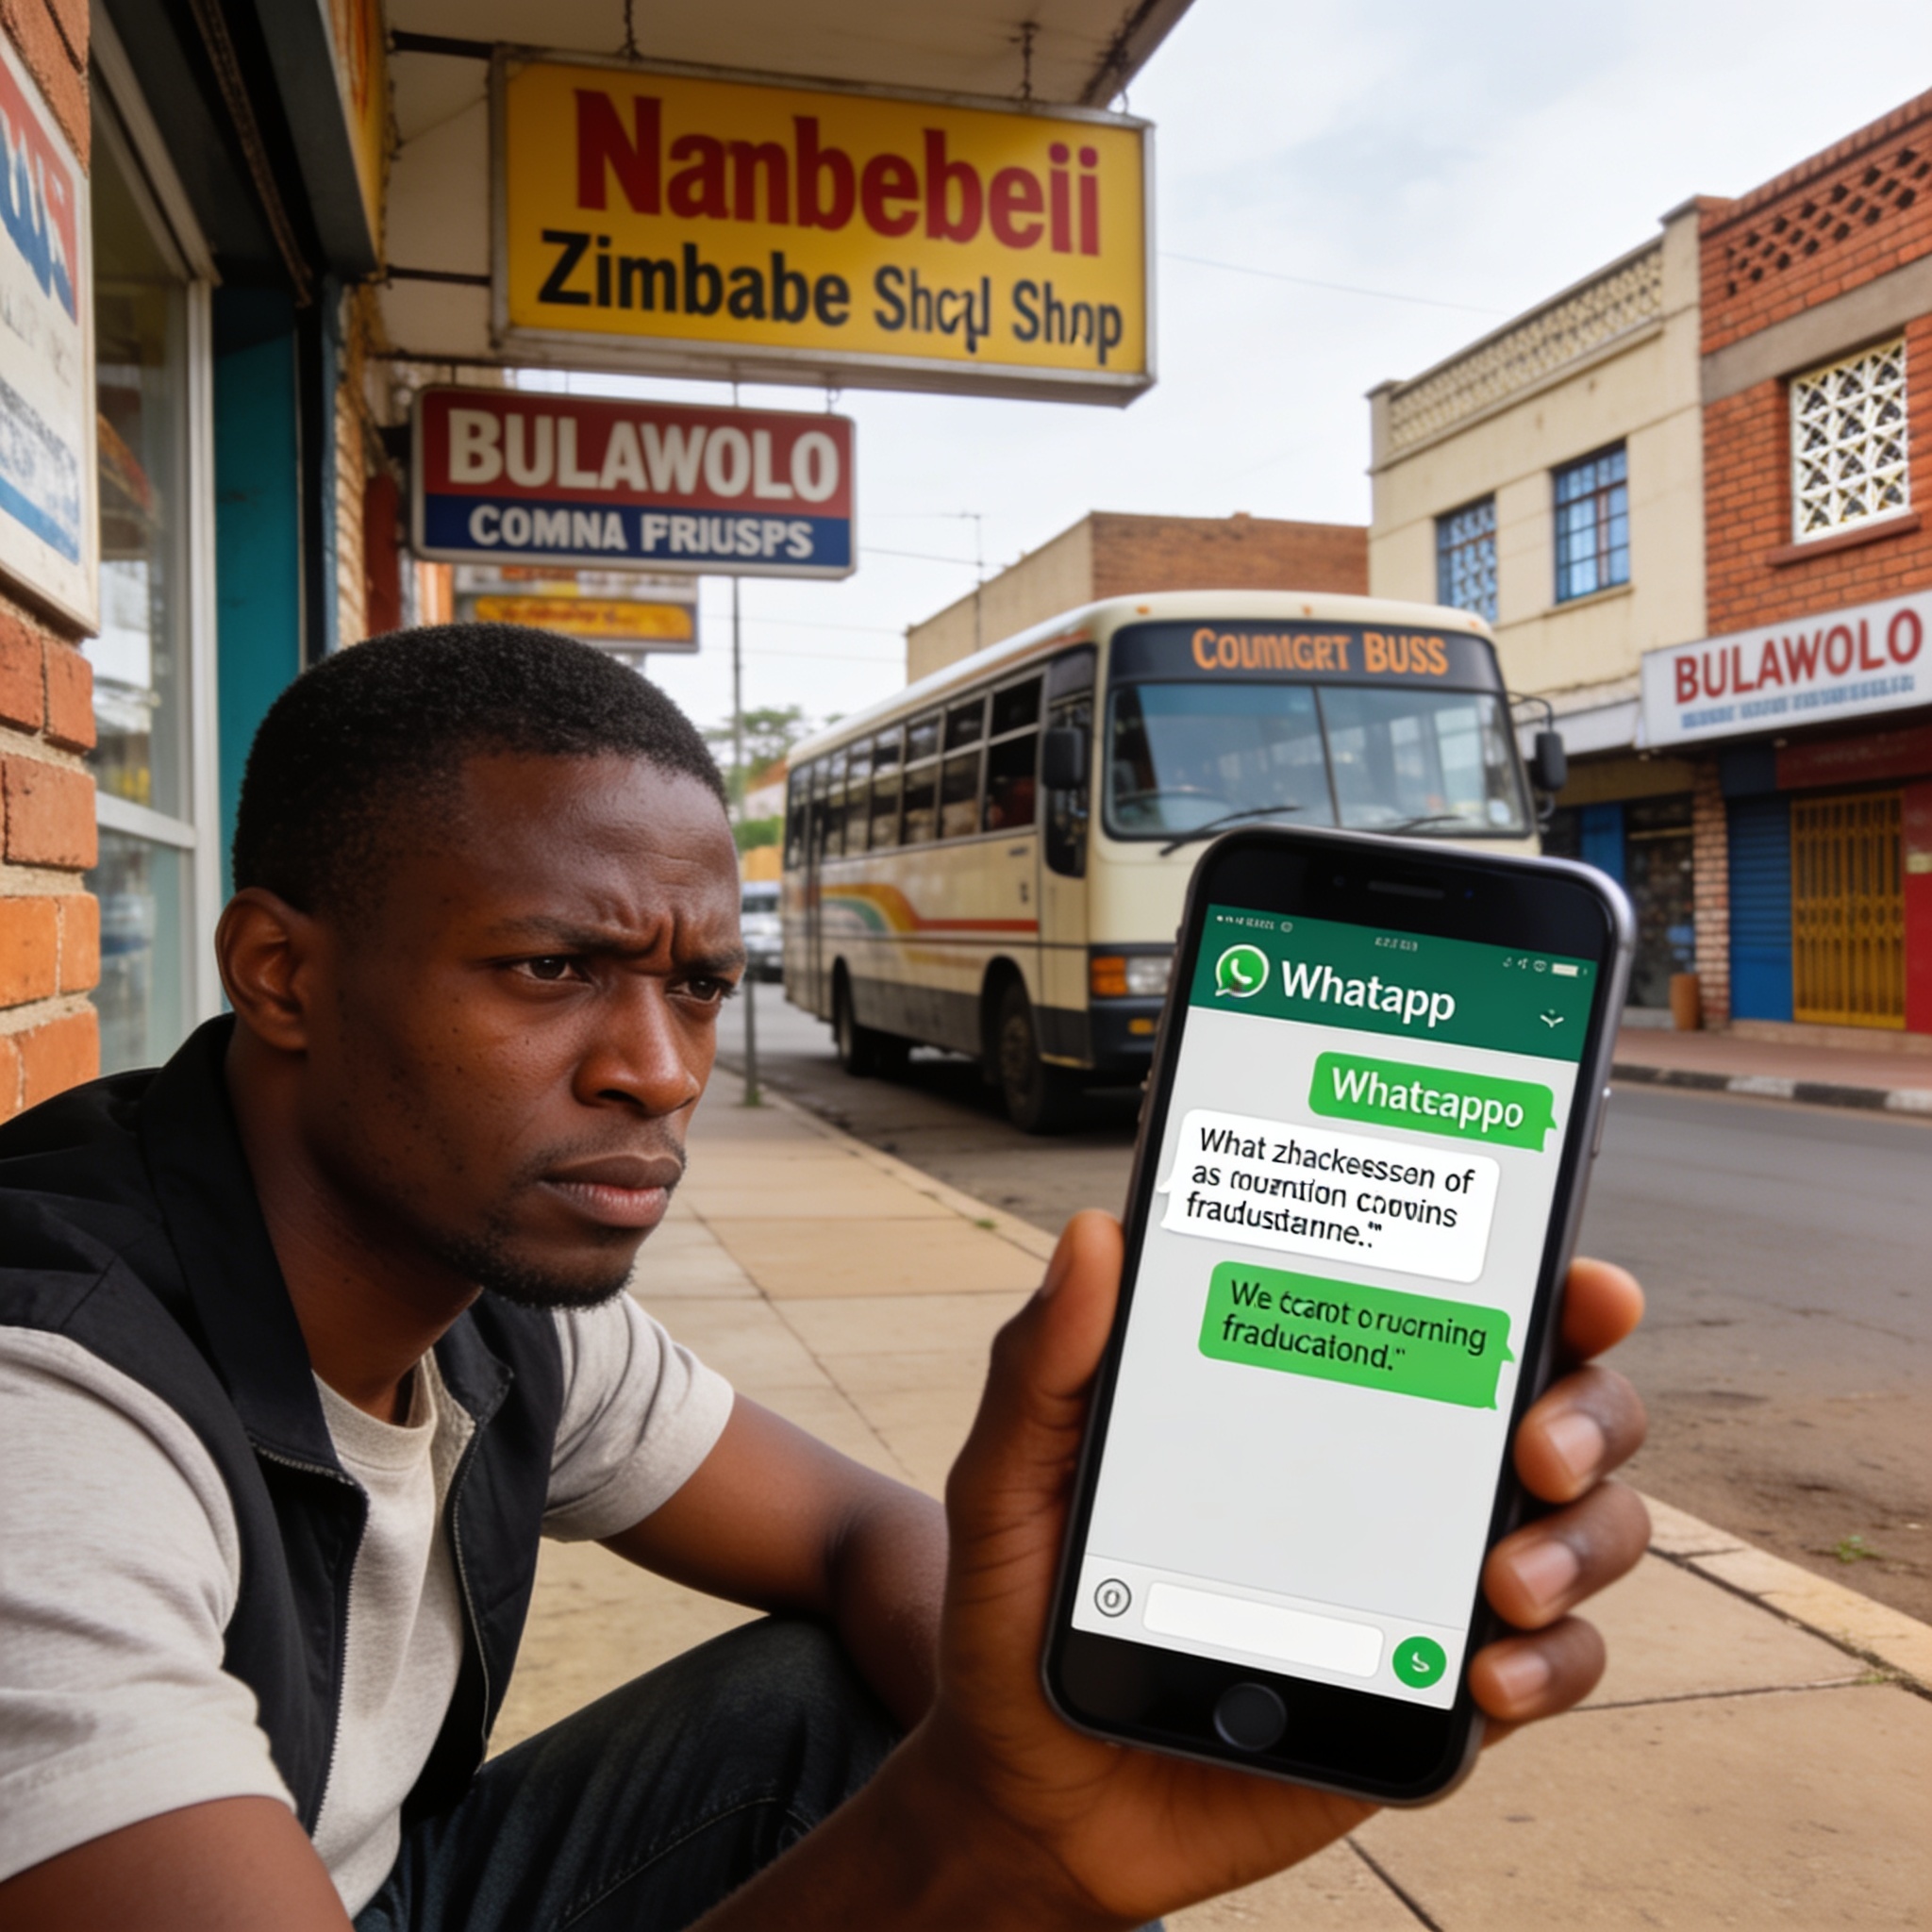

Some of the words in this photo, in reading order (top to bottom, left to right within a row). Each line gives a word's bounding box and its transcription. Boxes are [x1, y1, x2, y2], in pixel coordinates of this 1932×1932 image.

[574, 88, 1101, 258] Nanbebeii
[537, 229, 851, 328] Zimbabe
[447, 408, 840, 503] BULAWOLO
[469, 505, 628, 552] COMNA
[1361, 630, 1450, 677] BUSS
[1674, 608, 1924, 705] BULAWOLO
[1281, 959, 1456, 1028] Whatapp
[1192, 1165, 1221, 1187] as
[1200, 1126, 1266, 1160] What
[1444, 1169, 1475, 1195] of
[1231, 1279, 1273, 1310] We
